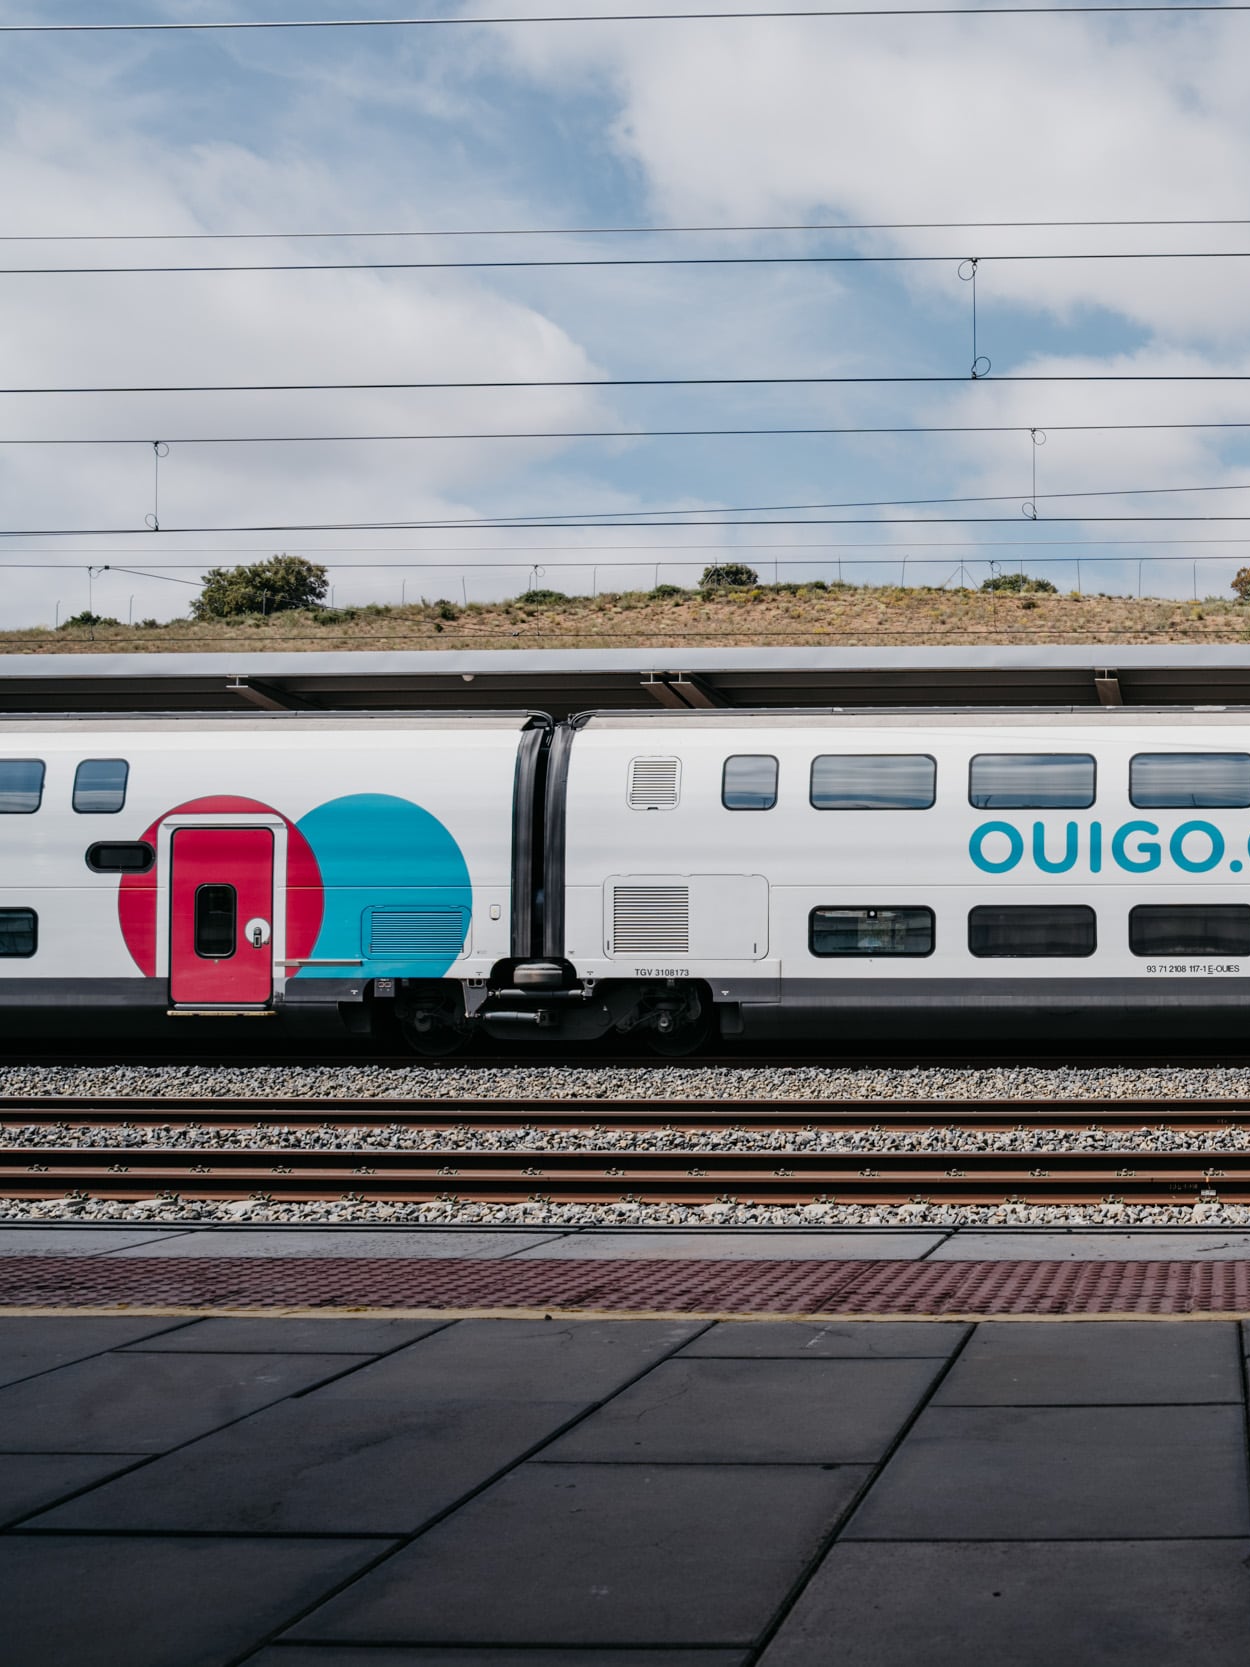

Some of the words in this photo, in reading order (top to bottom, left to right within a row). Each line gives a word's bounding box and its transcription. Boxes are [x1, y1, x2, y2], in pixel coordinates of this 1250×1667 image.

[634, 968, 653, 977] TGV
[655, 968, 690, 977] 3108173
[1146, 965, 1157, 973] 93
[1159, 965, 1167, 973] 71
[1169, 965, 1187, 973] 2108
